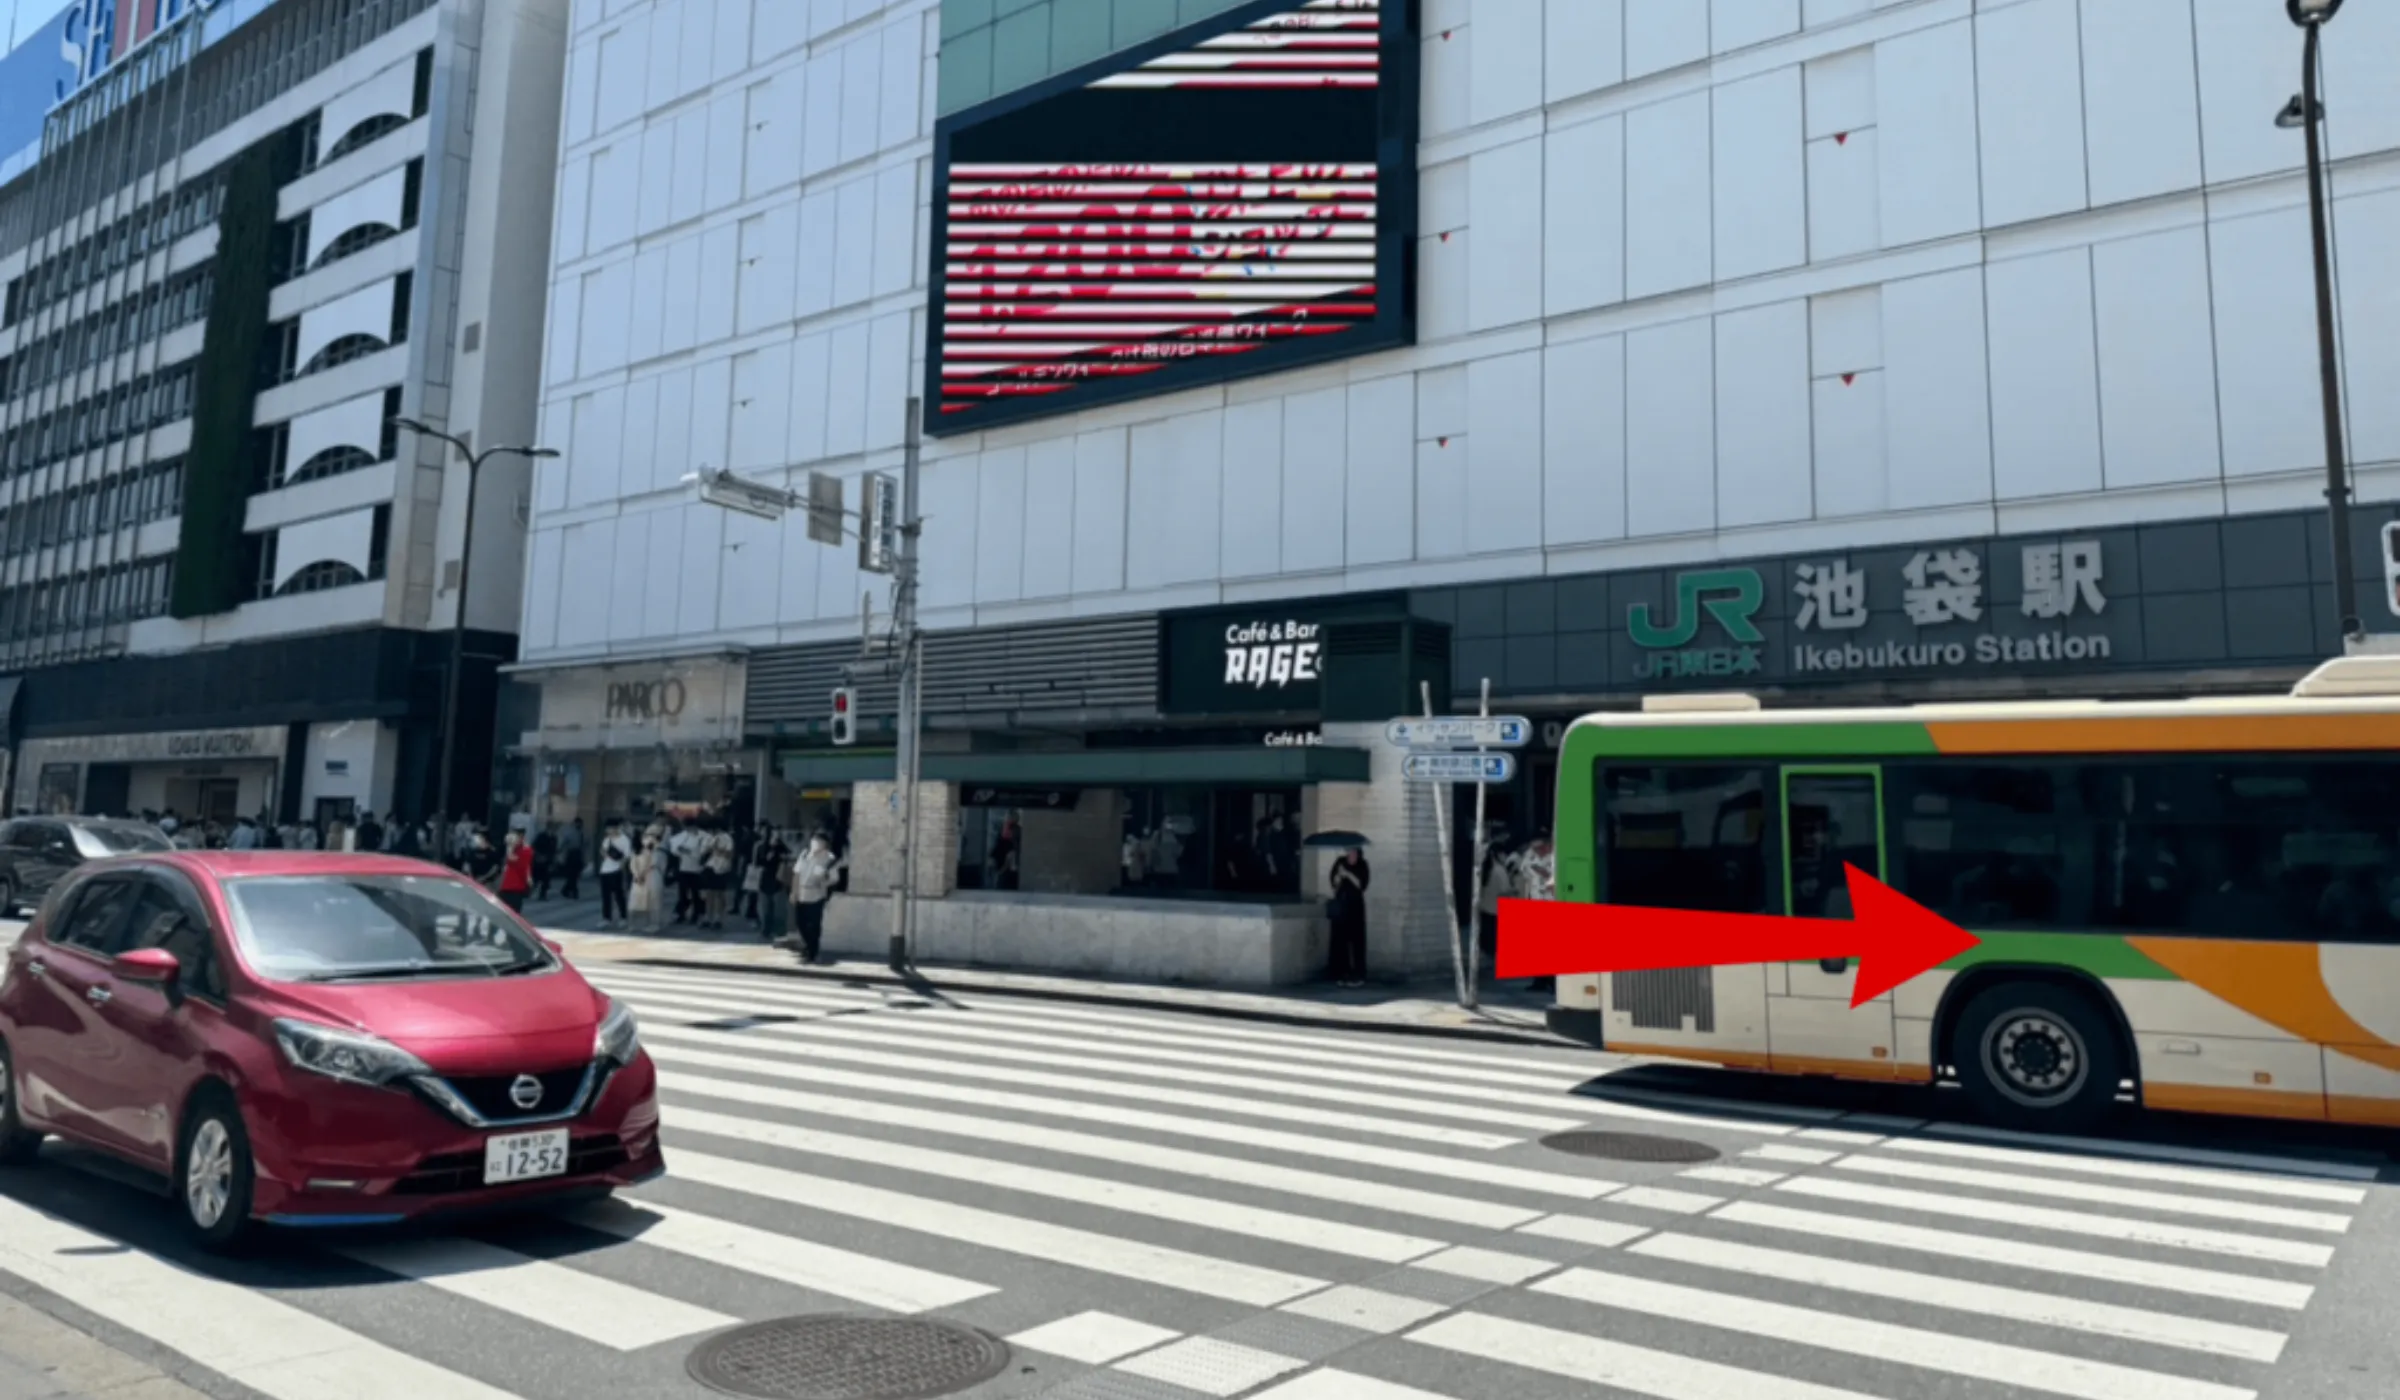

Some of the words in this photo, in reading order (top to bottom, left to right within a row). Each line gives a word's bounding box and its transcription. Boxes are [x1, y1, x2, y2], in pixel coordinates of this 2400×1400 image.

[1793, 540, 2106, 631] 池袋駅
[1627, 568, 1766, 647] JR
[1225, 622, 1267, 643] Café
[1270, 624, 1282, 640] &
[1284, 619, 1320, 640] Bar
[1633, 645, 1762, 678] JR東日本
[1795, 641, 1966, 671] Ikebukuro
[1975, 631, 2111, 662] Station
[606, 677, 686, 719] PARCO
[1306, 730, 1322, 745] Ba
[506, 1147, 564, 1176] 12-52
